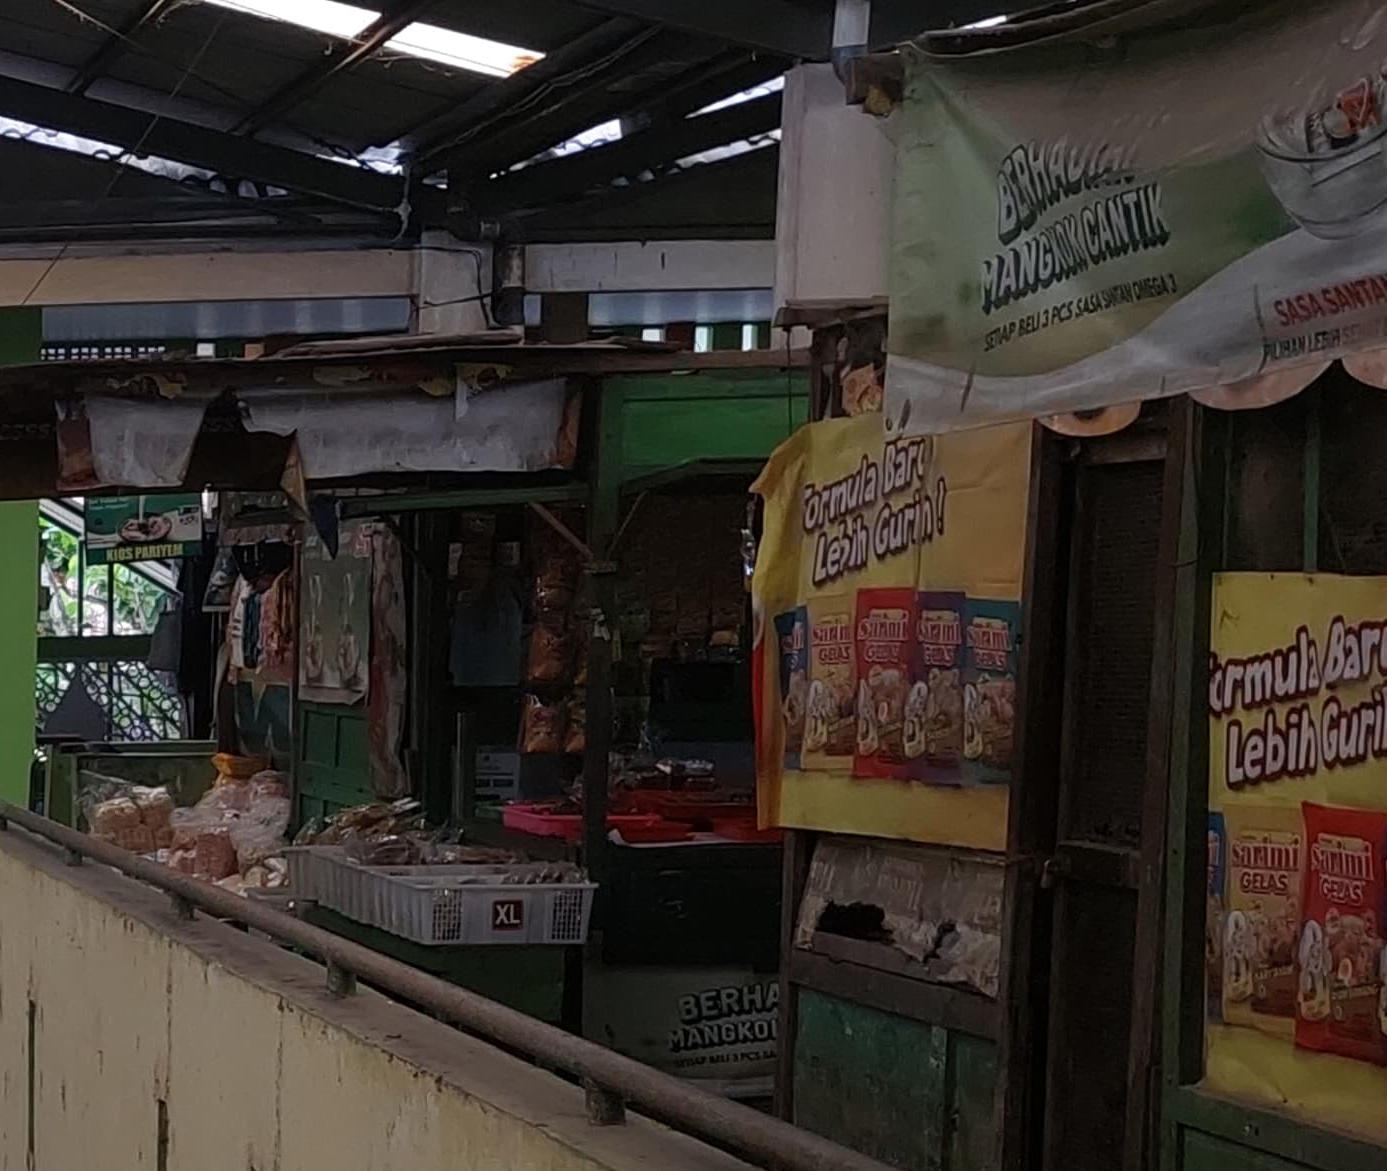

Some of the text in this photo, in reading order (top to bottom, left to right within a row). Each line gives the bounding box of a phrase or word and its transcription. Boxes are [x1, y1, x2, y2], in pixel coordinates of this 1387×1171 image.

[1081, 181, 1171, 265] CANTIK
[1018, 312, 1042, 338] BELI
[1051, 300, 1075, 325] PCS
[1273, 291, 1324, 326] SASA
[1225, 703, 1318, 791] Lebih
[1240, 871, 1289, 898] GELAS
[1320, 876, 1364, 905] GELAS
[495, 903, 521, 925] XL
